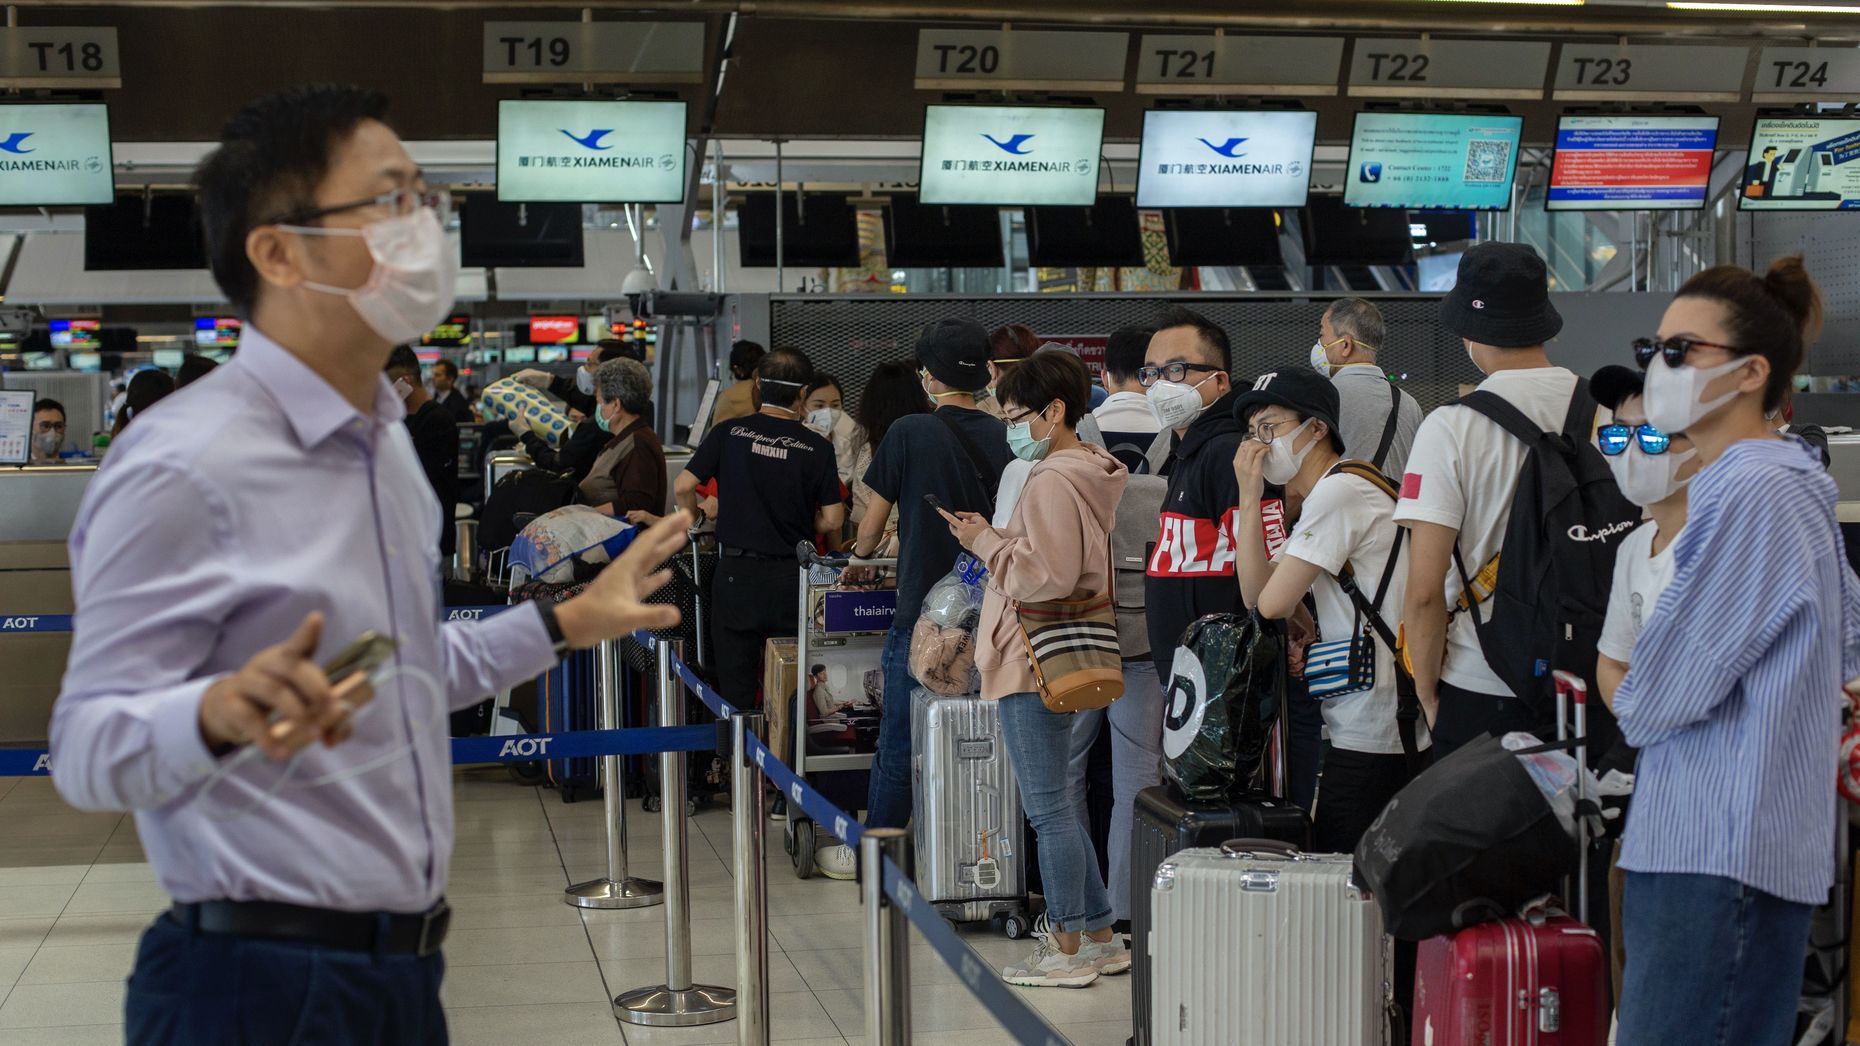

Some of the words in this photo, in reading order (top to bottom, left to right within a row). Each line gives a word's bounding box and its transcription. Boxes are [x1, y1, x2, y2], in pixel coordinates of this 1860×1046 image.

[28, 42, 103, 71] T18
[500, 37, 570, 66] T19
[933, 45, 999, 73] T20
[1155, 50, 1215, 78] T21
[1367, 53, 1430, 81] T22
[1573, 57, 1632, 85] T23
[1773, 61, 1829, 88] T24
[572, 156, 654, 168] XIAMENAIR
[993, 161, 1070, 172] XIAMENAIR
[1208, 164, 1283, 175] XIAMENAIR
[730, 426, 780, 446] Bulletproof
[780, 436, 814, 452] Edition
[751, 442, 788, 460] MMXIII
[3, 617, 39, 629] AOT
[448, 609, 483, 620] AOT
[499, 737, 552, 757] AOT
